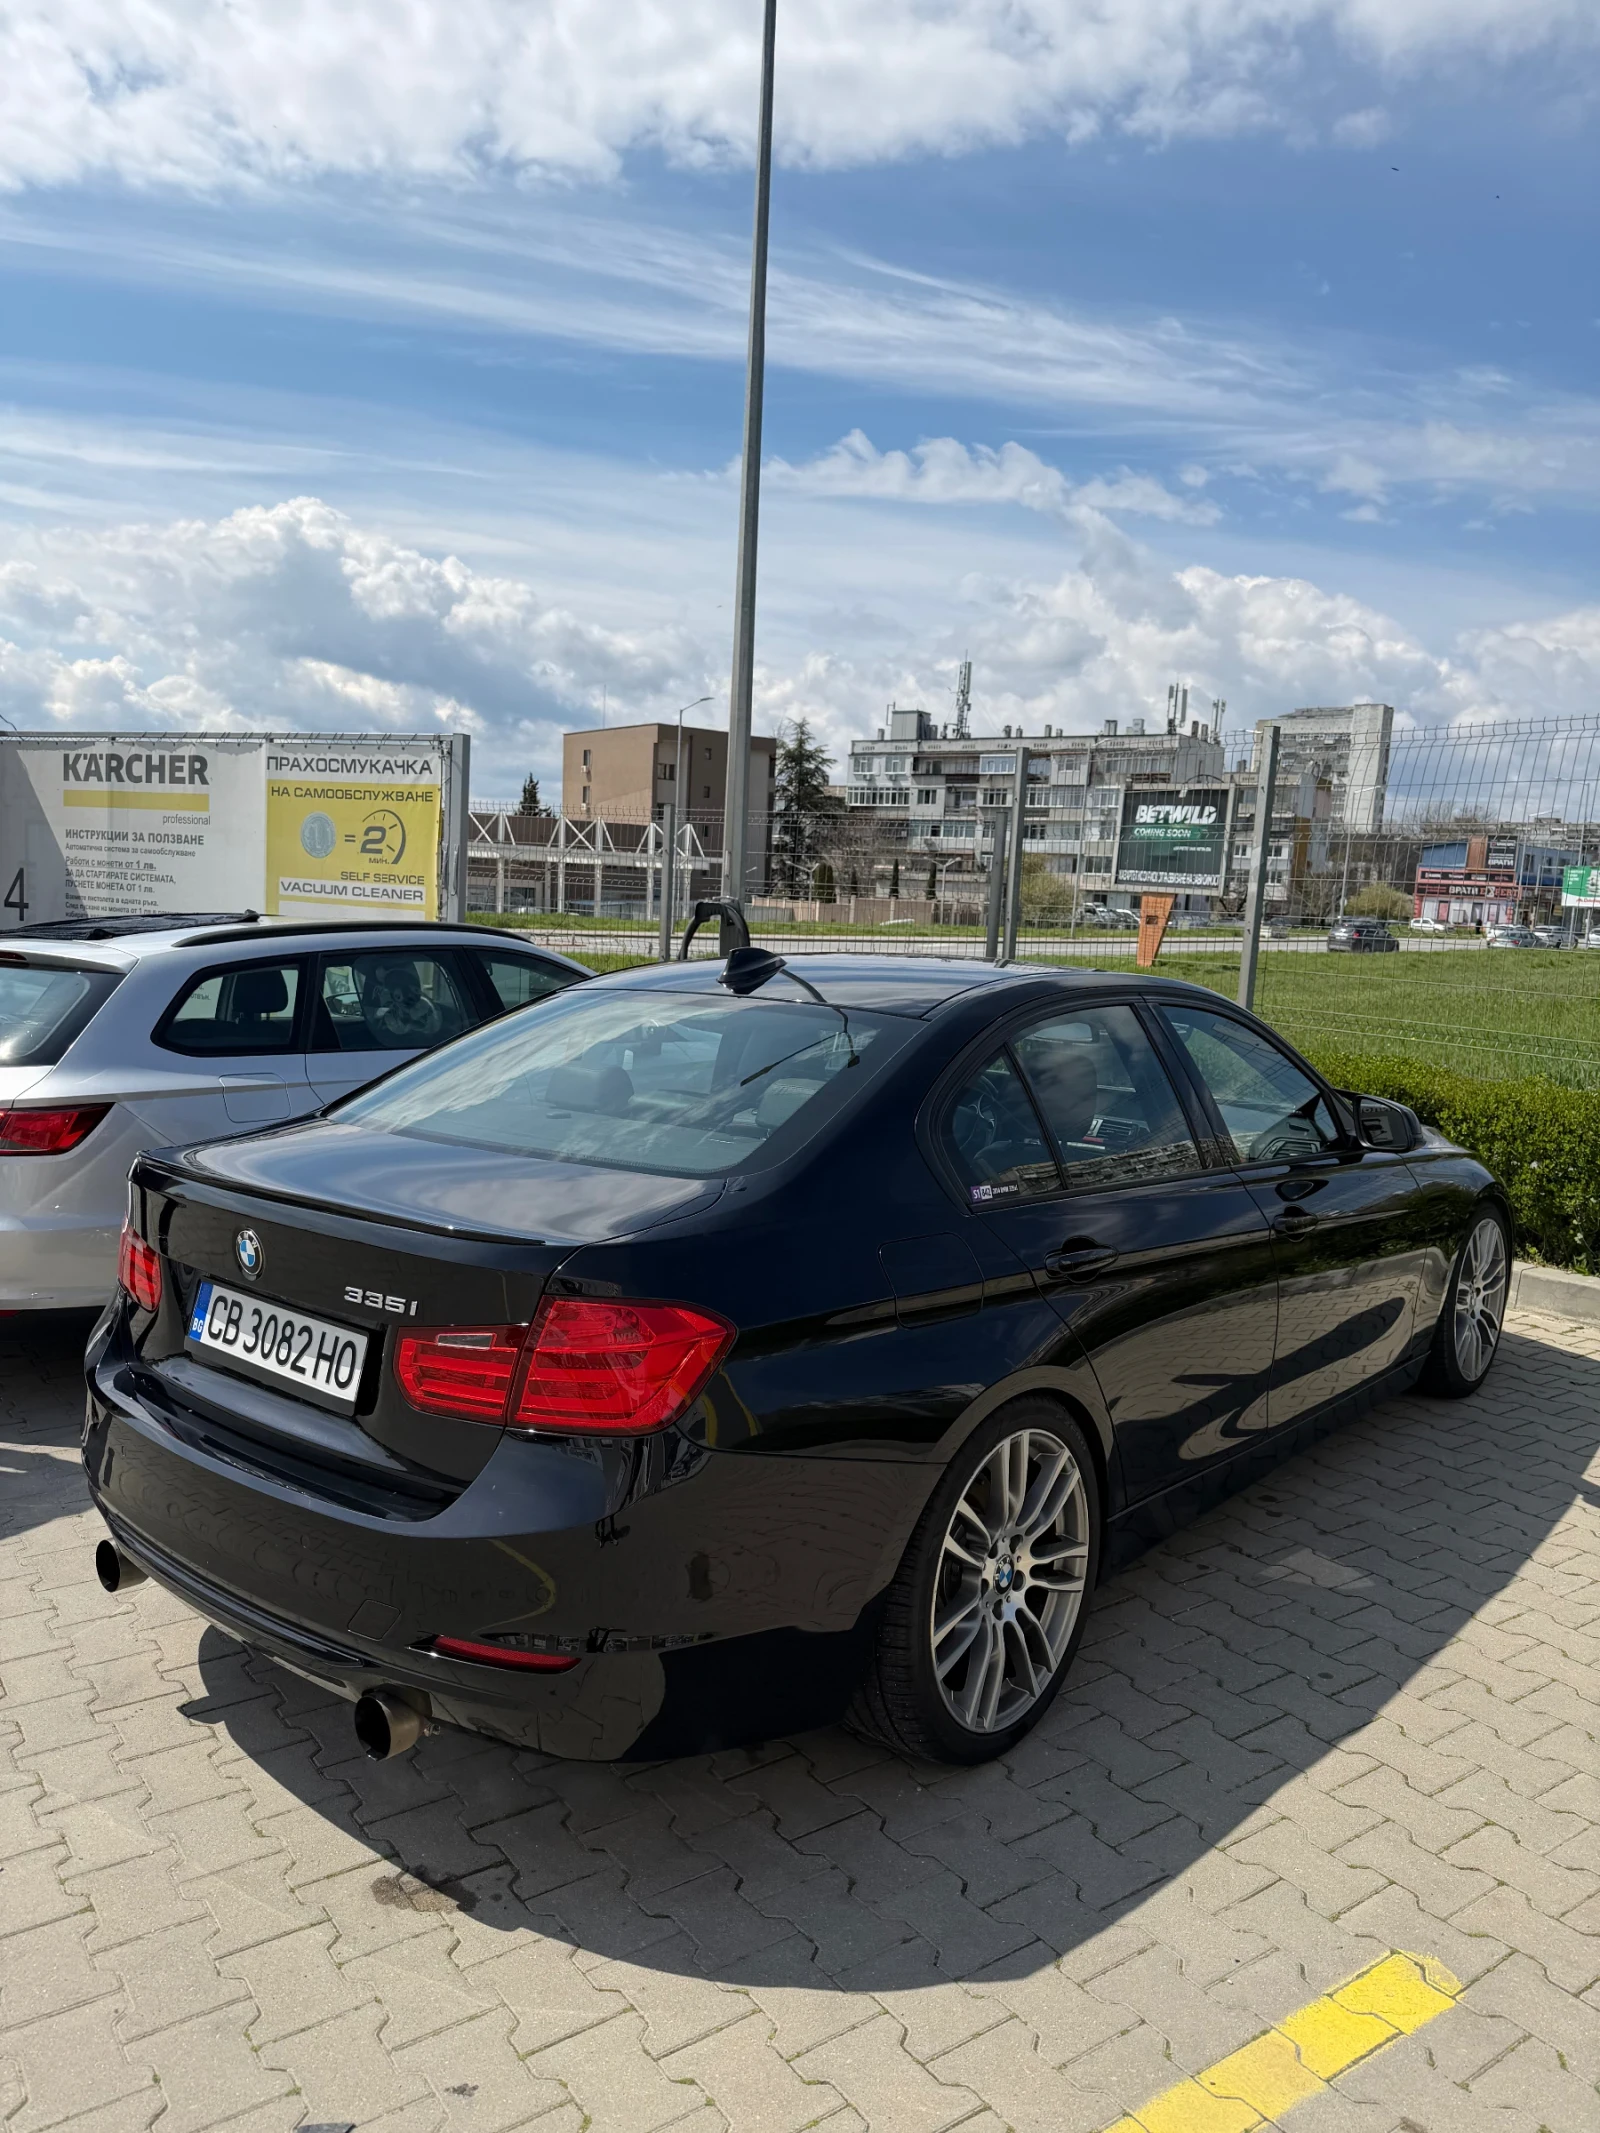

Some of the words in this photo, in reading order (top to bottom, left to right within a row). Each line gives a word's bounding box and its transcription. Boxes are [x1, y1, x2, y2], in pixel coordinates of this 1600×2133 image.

[63, 753, 210, 785] KÄRCHER
[266, 756, 433, 775] ПРАХОСМУКАЧКА
[271, 786, 290, 797] НА
[294, 787, 433, 802] САМООБСЛУЖВАНЕ
[163, 814, 211, 826] professional
[1135, 804, 1217, 824] BETWILD
[65, 829, 129, 843] ИНСТРУКЦИИ
[132, 832, 145, 843] ЗА
[148, 832, 205, 846] ПОЛЗВАНЕ
[1134, 827, 1165, 837] COMING
[1166, 828, 1192, 837] SOON
[360, 826, 387, 855] 2
[65, 843, 103, 852] Автоматична
[104, 845, 129, 853] система
[140, 847, 196, 858] самообслужване
[65, 856, 90, 866] Работи
[97, 860, 124, 868] монети
[136, 860, 141, 869] 1
[143, 862, 157, 870] лв.
[65, 868, 74, 877] ЗА
[75, 869, 85, 879] ДА
[86, 870, 128, 881] СТАРТИРАТЕ
[130, 872, 176, 884] СИСТЕМАТА,
[340, 871, 370, 883] SELF
[373, 873, 425, 885] SERVICE
[4, 867, 29, 921] 4
[65, 879, 95, 889] ПУСНЕТЕ
[96, 881, 125, 891] МОНЕТА
[126, 882, 136, 892] ОТ
[138, 884, 142, 892] 1
[144, 885, 155, 893] лв.
[280, 880, 348, 896] VACUUM
[351, 886, 424, 901] CLEANER
[1449, 885, 1479, 895] ВРАТИ
[108, 905, 130, 913] монета
[121, 898, 141, 906] едната
[192, 1317, 204, 1333] BG
[207, 1295, 243, 1346] CB
[243, 1307, 313, 1376] 3082
